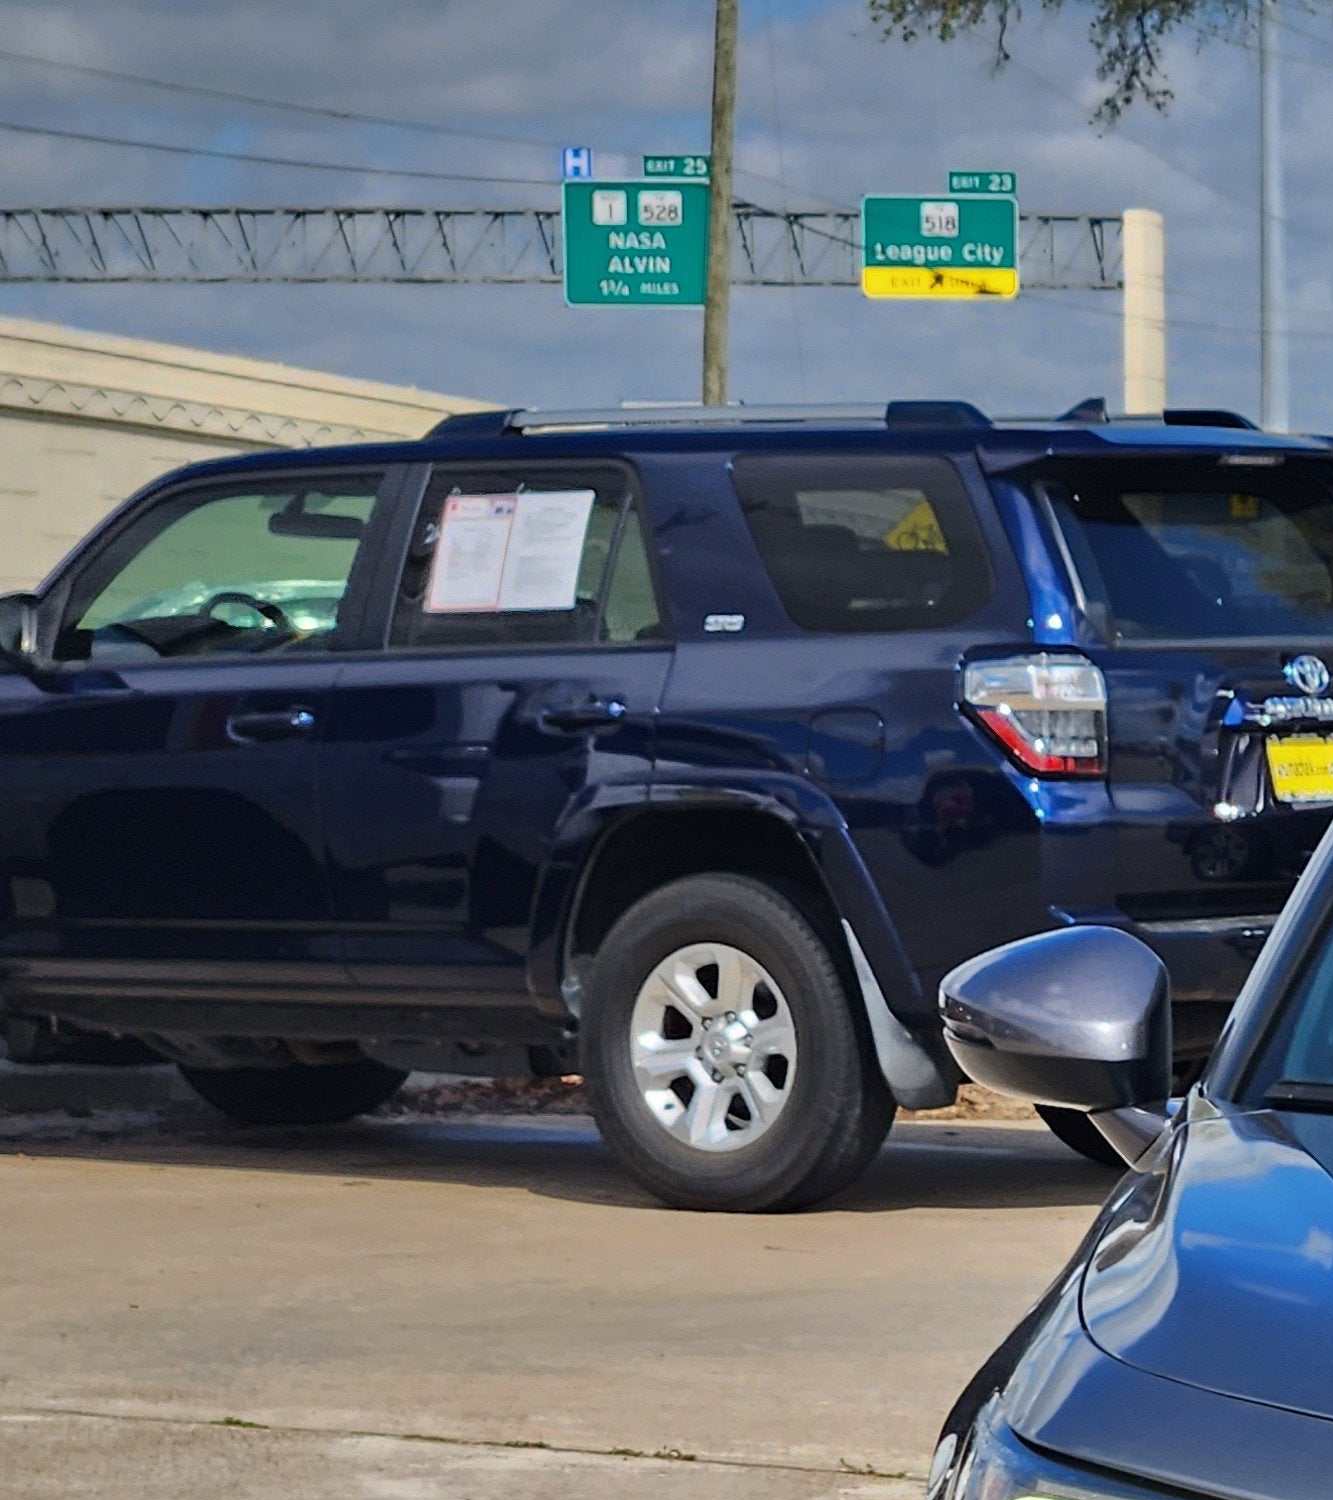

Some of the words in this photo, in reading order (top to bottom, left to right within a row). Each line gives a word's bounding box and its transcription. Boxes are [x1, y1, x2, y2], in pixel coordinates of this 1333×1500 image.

[646, 159, 675, 172] EXIT
[952, 176, 979, 189] EXIT
[988, 174, 1012, 191] 23
[643, 204, 679, 221] 528
[925, 215, 956, 232] 518
[608, 231, 666, 249] NASA
[874, 243, 952, 265] League
[962, 243, 1004, 265] City
[608, 256, 670, 273] ALVIN
[640, 282, 680, 295] MILES
